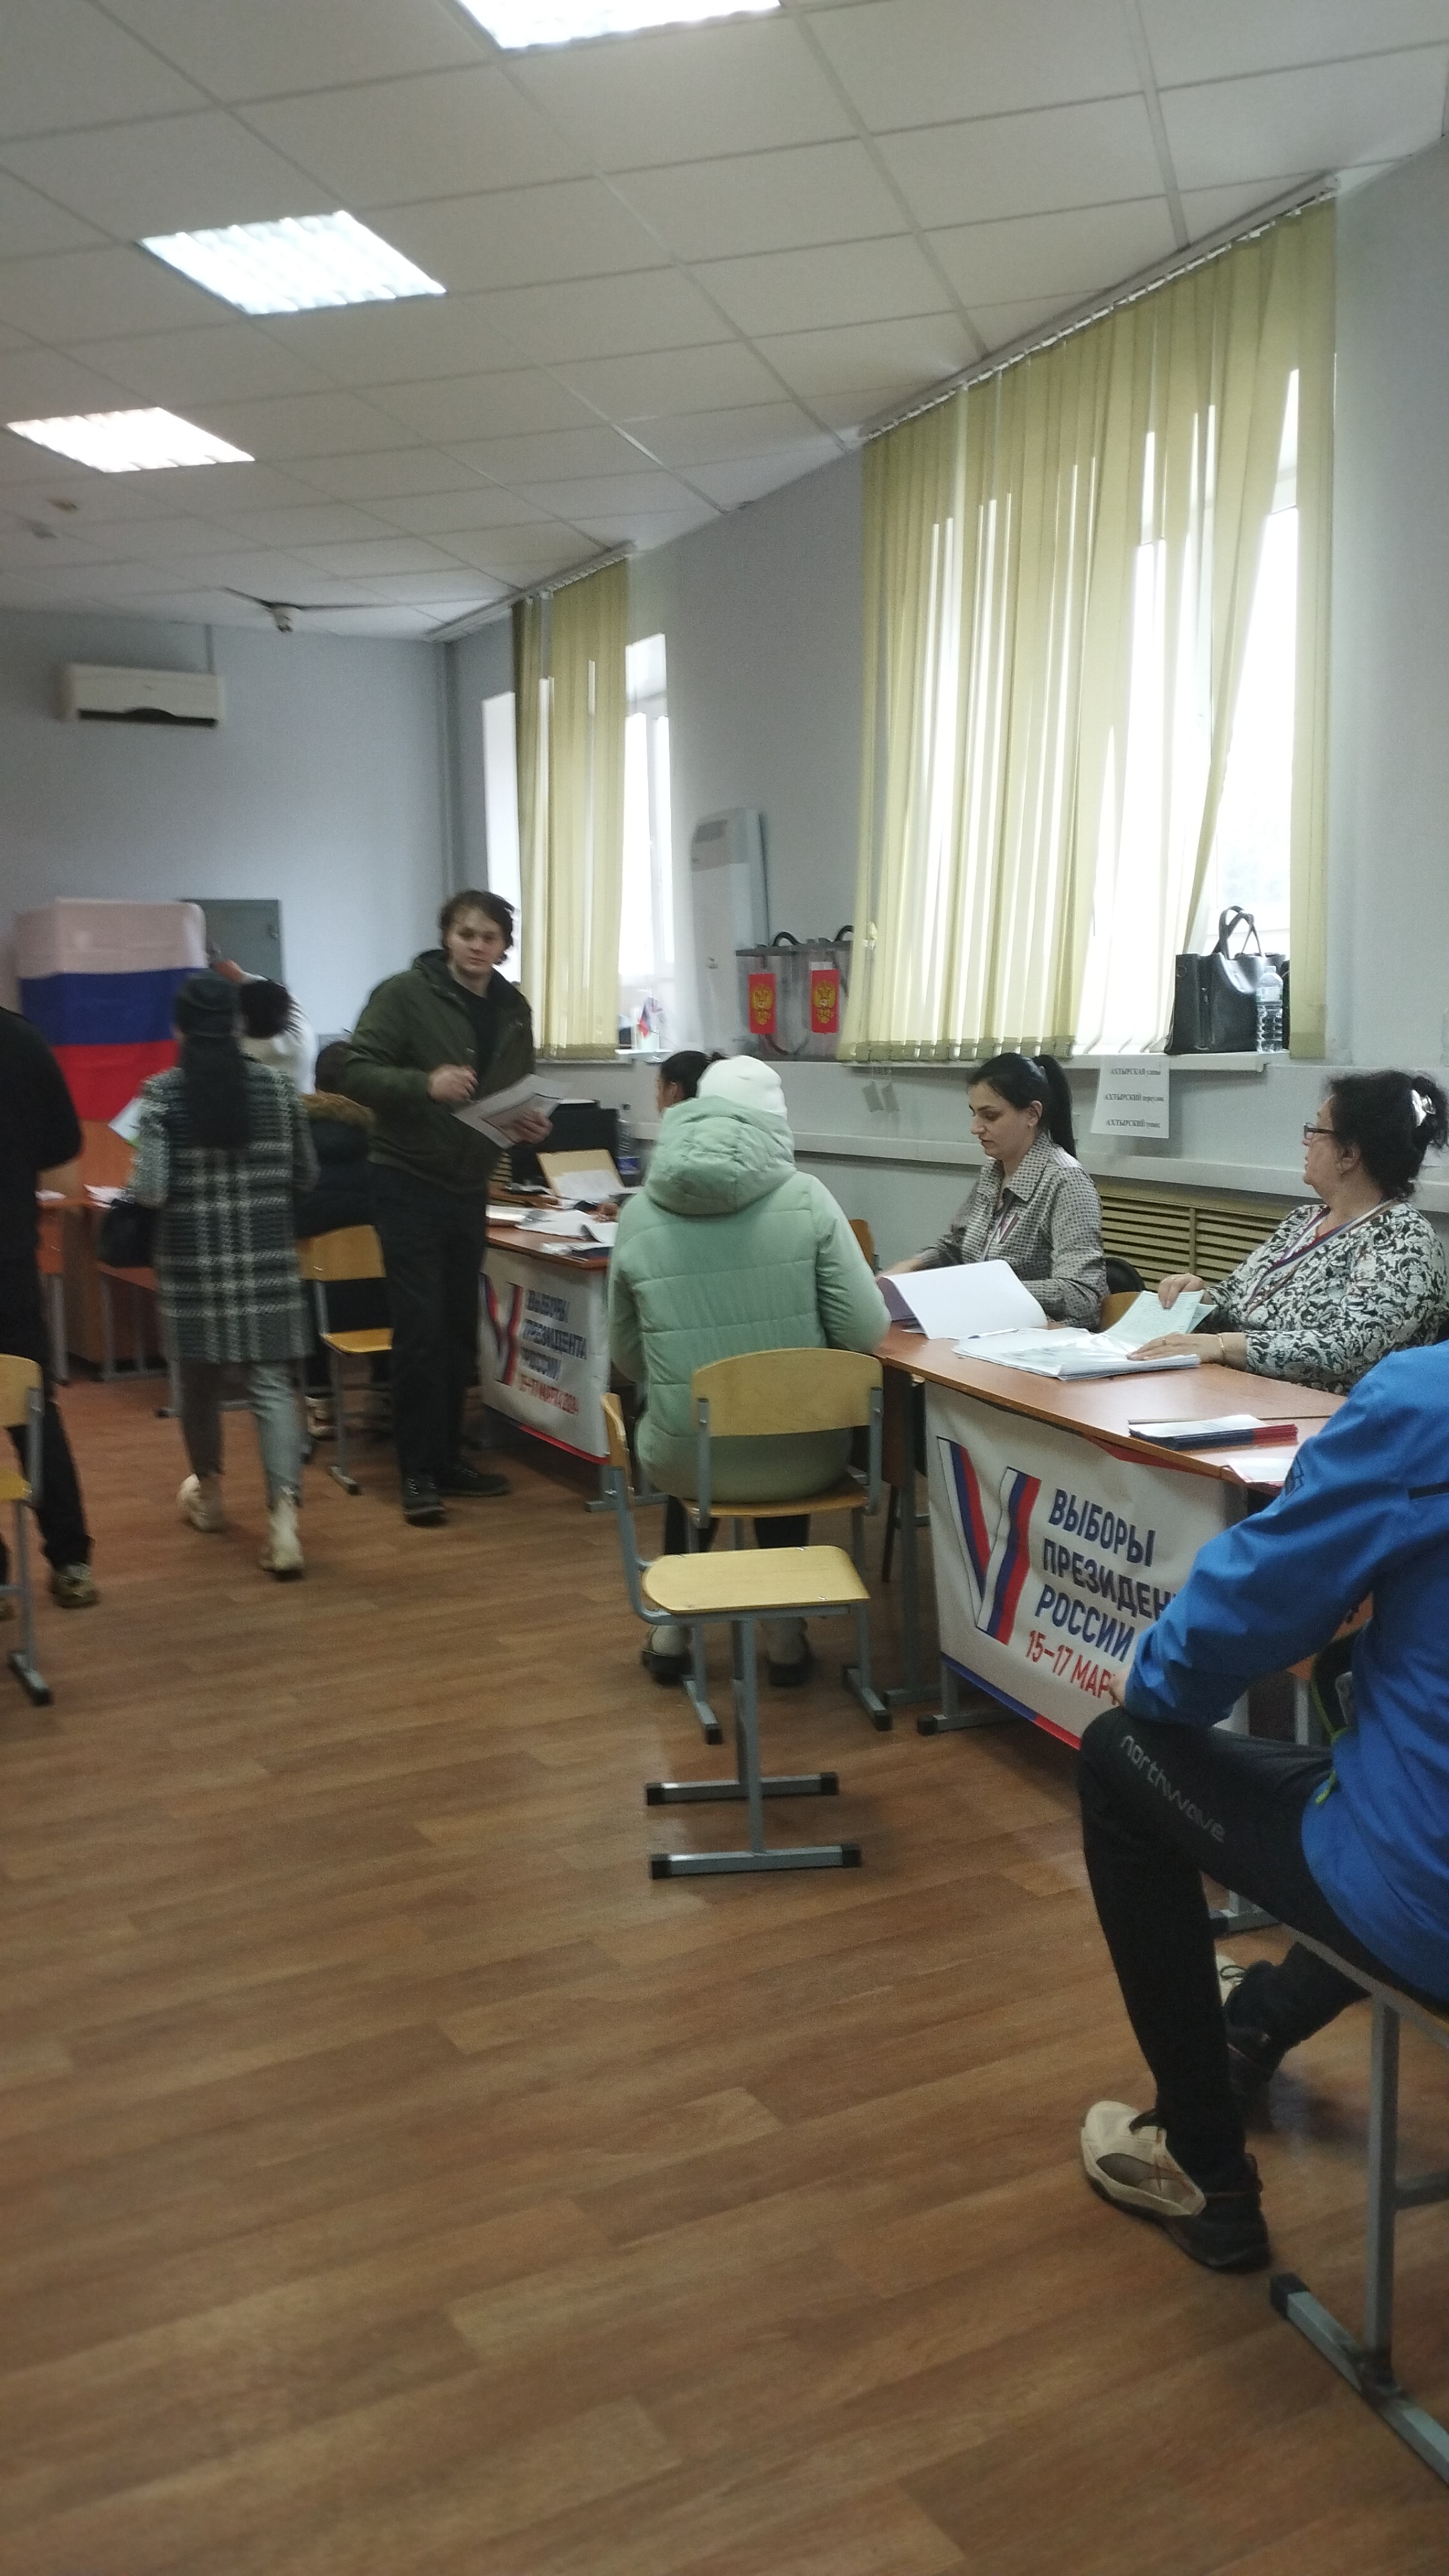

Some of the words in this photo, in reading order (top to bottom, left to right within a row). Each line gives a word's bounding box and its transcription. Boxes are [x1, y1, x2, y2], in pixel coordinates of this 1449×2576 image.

[1048, 1489, 1156, 1567] ВЫБОРЫ
[1042, 1538, 1176, 1621] ПРЕЗИДЕН
[1035, 1583, 1136, 1662] РОССИИ
[1070, 1654, 1114, 1699] МАР
[1120, 1735, 1226, 1843] northwave
